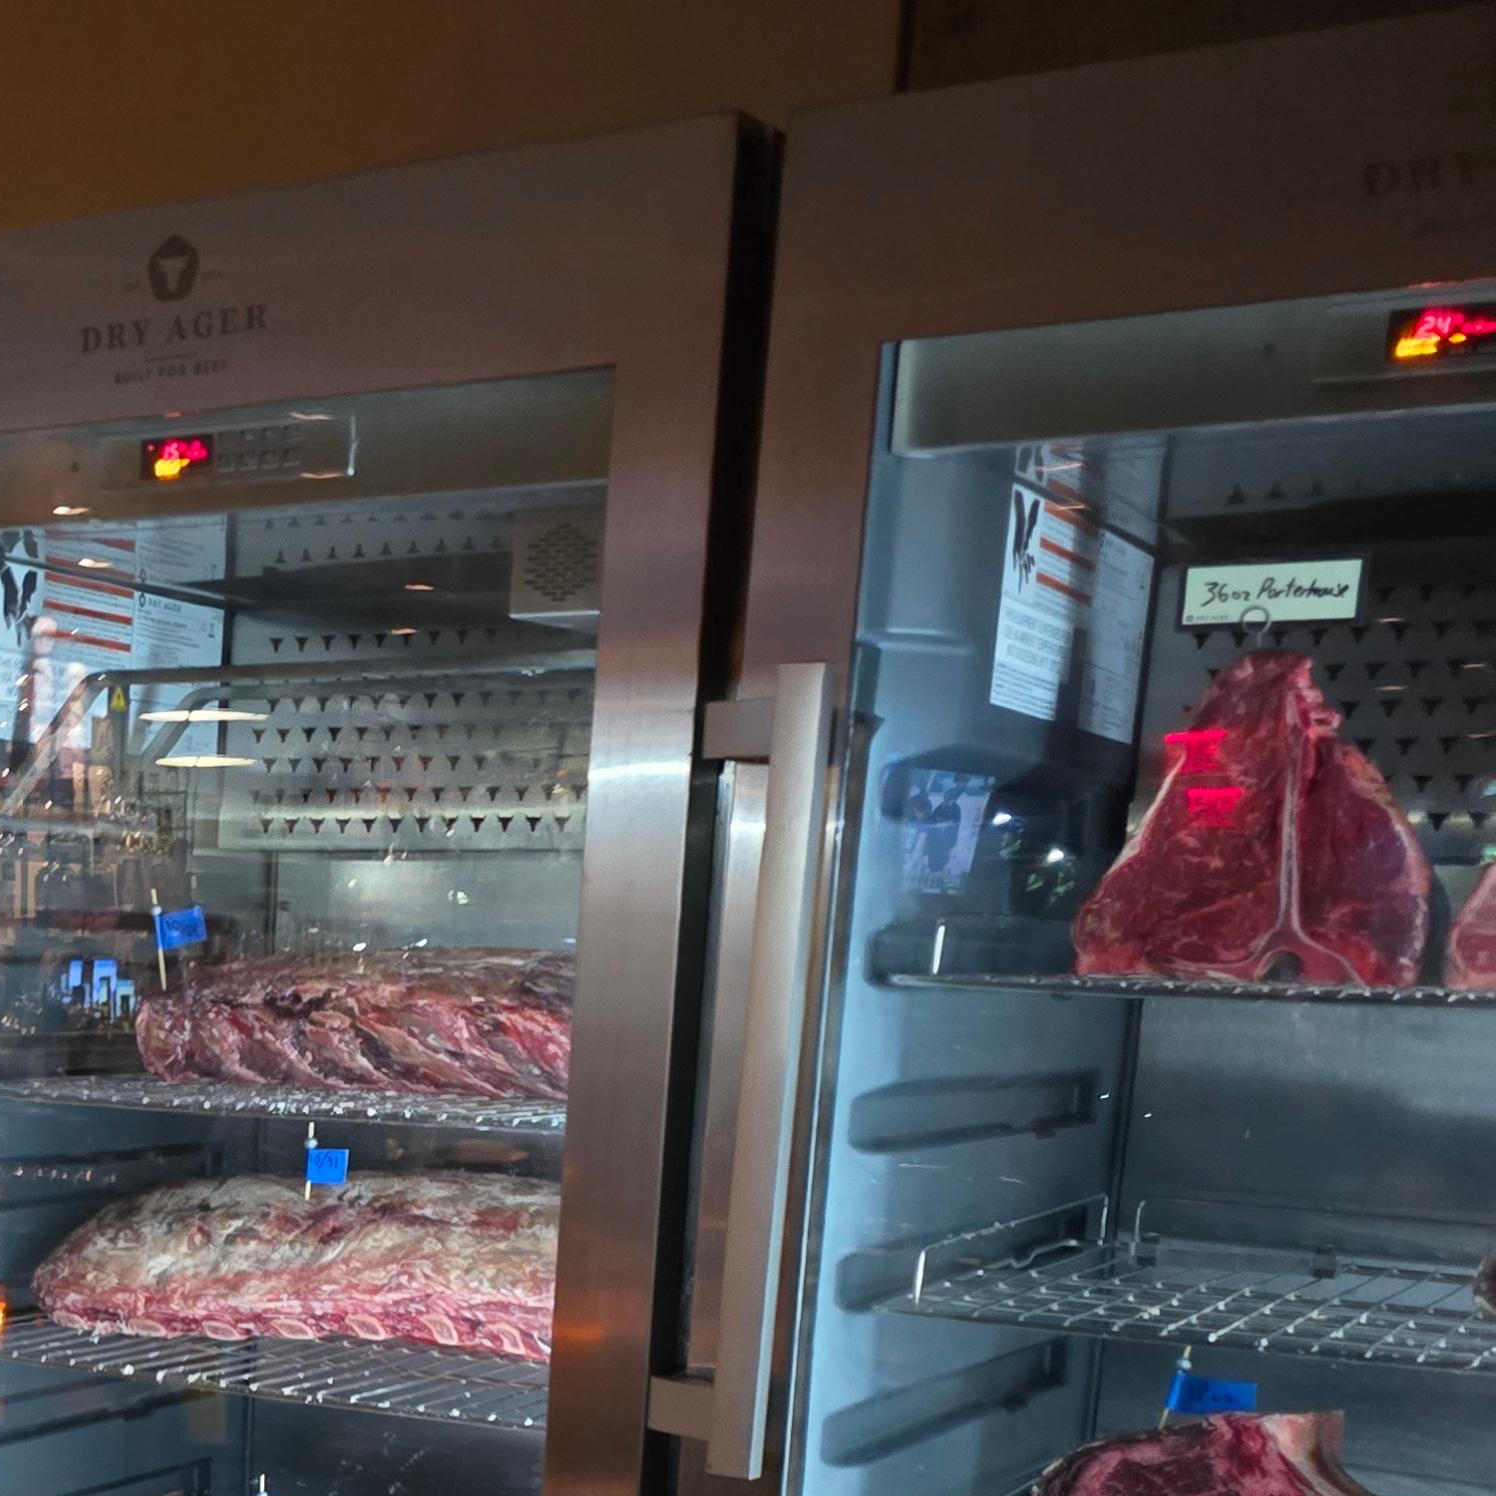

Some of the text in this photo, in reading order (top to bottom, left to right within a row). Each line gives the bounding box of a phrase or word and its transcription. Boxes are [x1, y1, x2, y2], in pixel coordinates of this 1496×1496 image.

[80, 304, 267, 355] DRY AGER
[1257, 577, 1350, 601] Porterhouse
